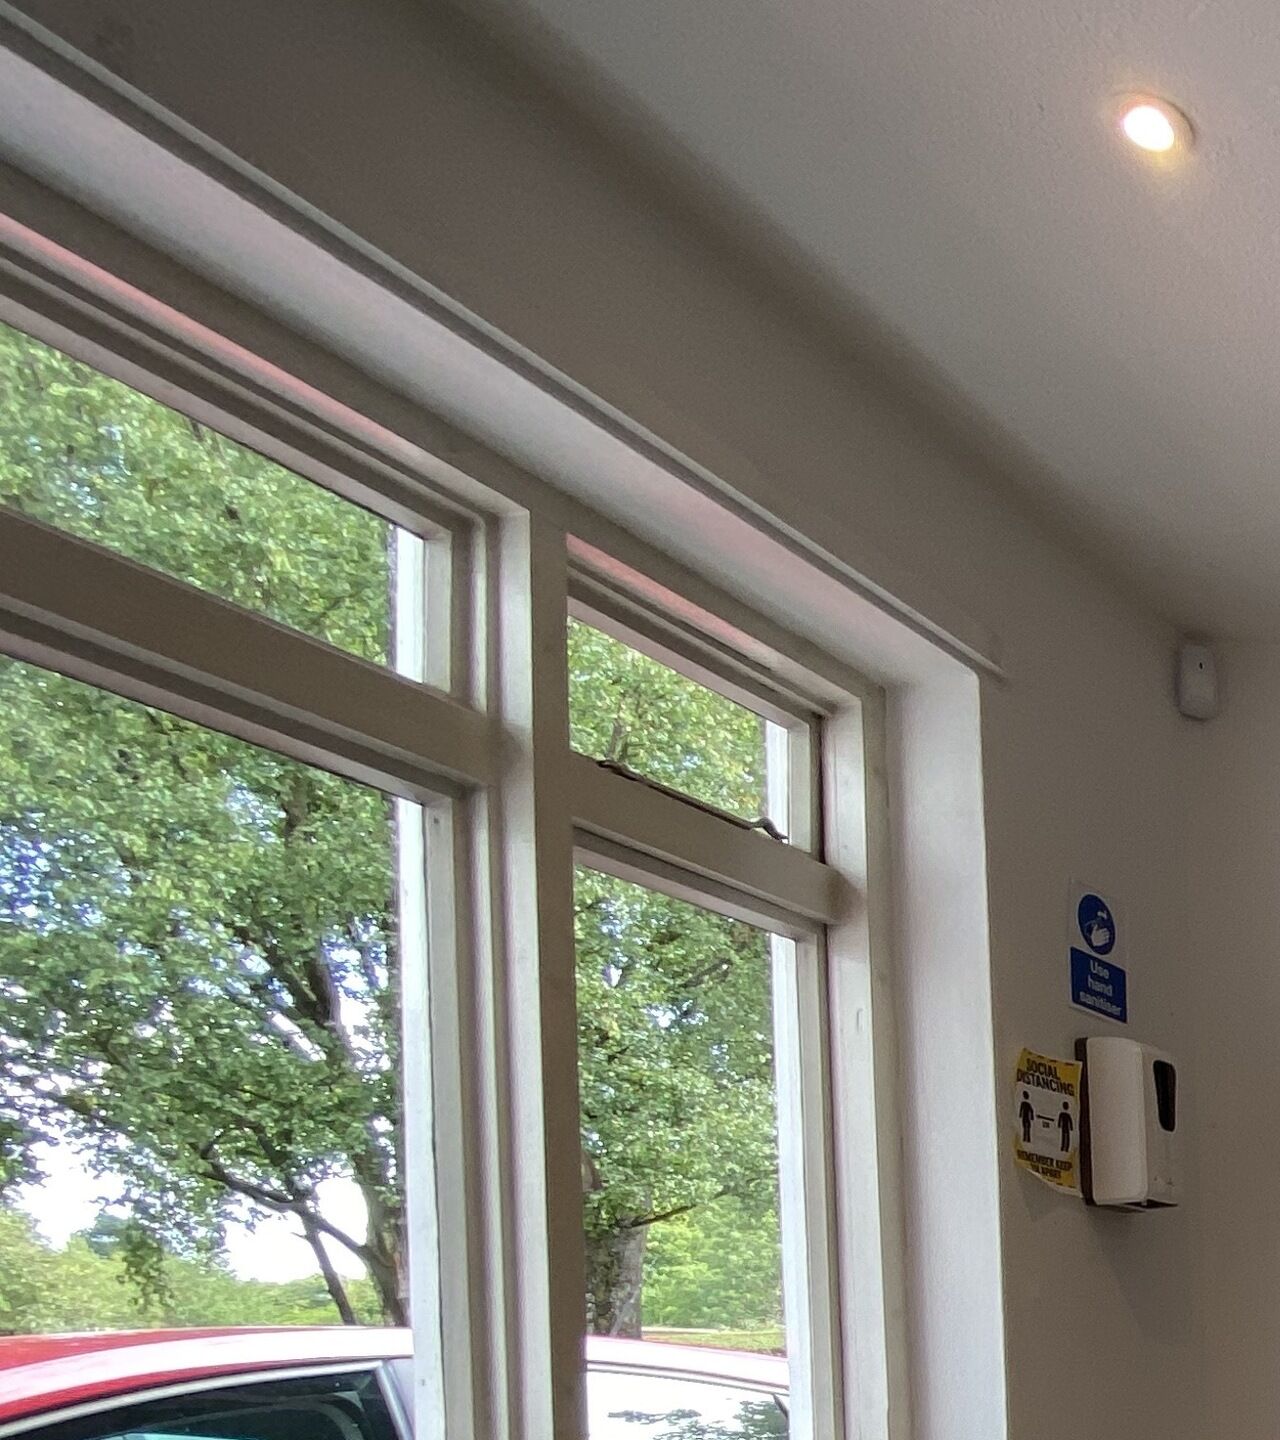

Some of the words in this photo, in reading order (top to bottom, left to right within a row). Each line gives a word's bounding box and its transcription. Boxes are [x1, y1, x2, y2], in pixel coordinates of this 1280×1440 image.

[1089, 959, 1110, 980] Use
[1087, 974, 1113, 997] hand
[1026, 1058, 1061, 1081] SOCIAL
[1016, 1068, 1075, 1097] DISTANCING
